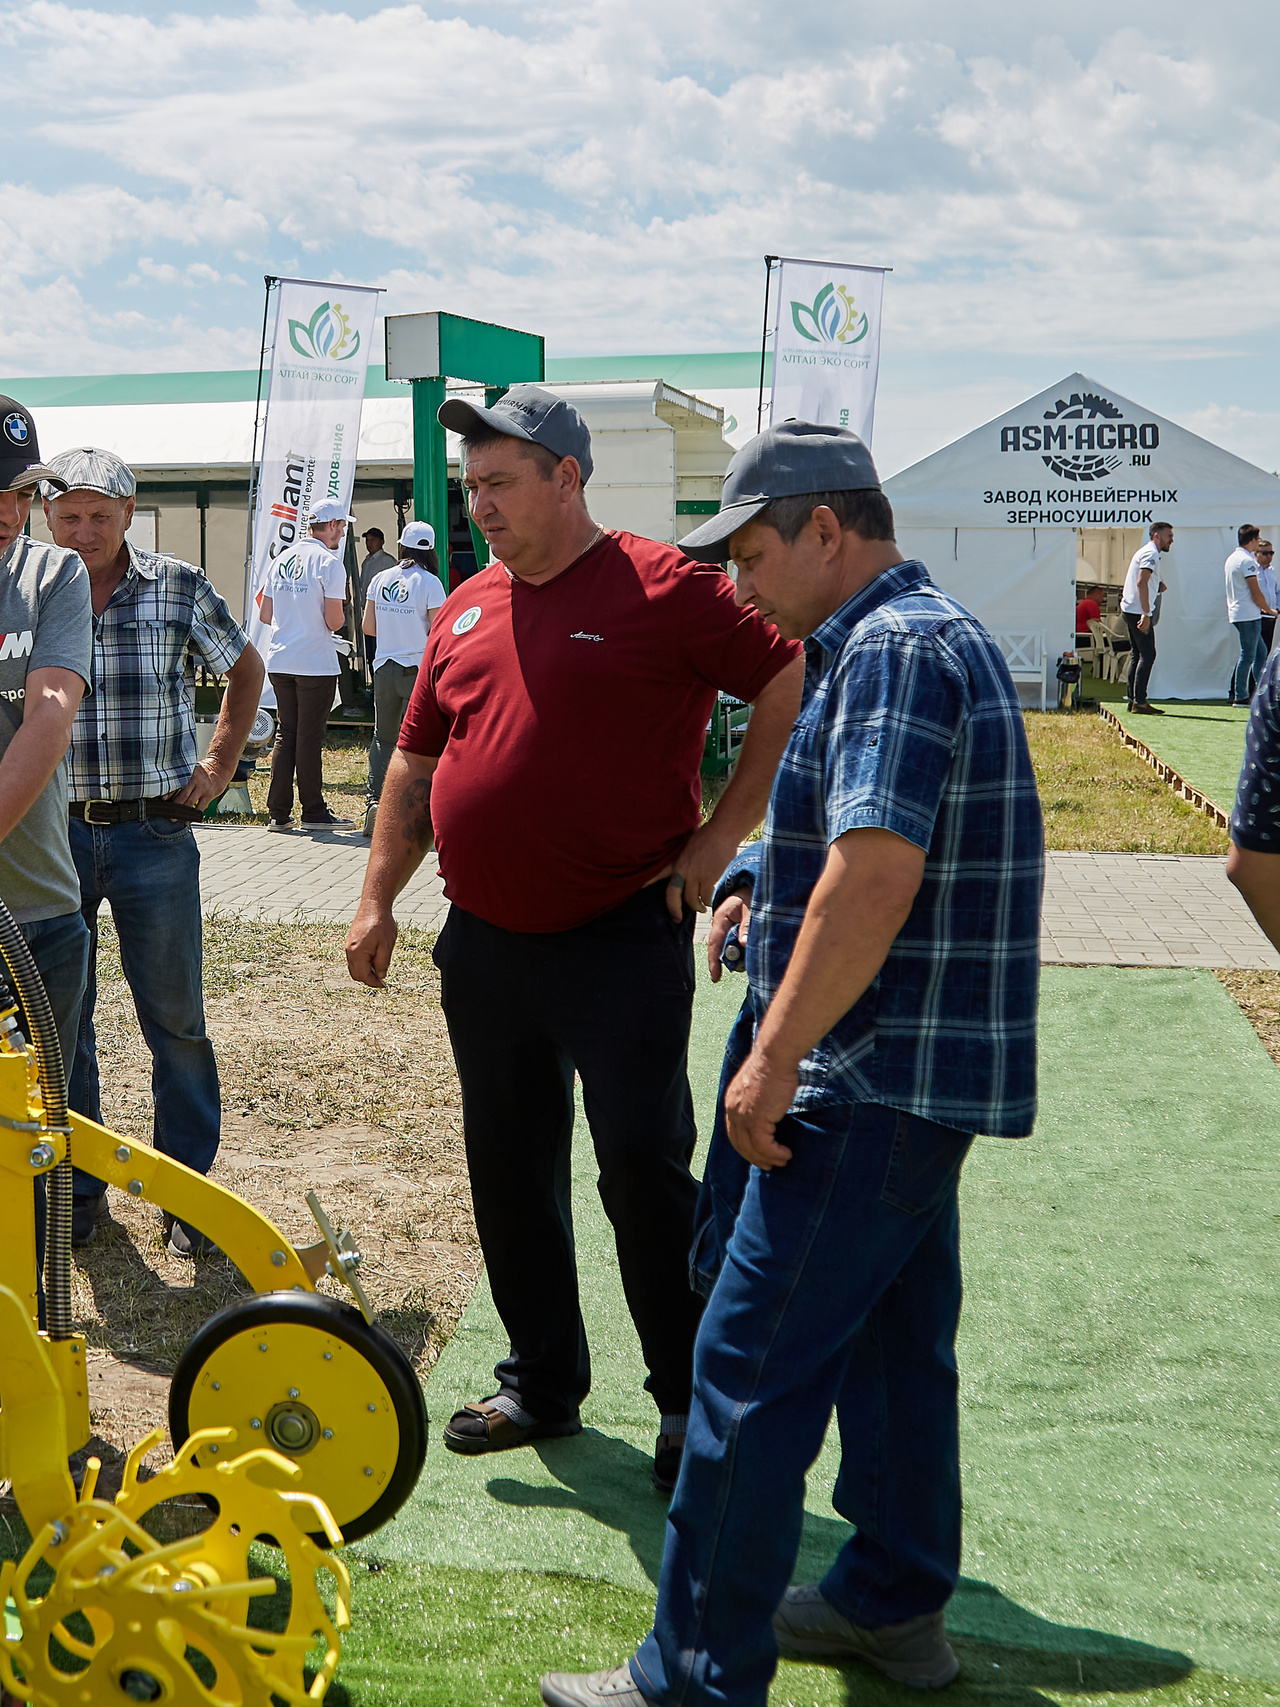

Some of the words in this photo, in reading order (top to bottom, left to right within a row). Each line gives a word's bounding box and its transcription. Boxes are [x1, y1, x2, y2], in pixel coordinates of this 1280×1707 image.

[782, 354, 817, 365] АЛТАЙ
[820, 356, 841, 367] ЭКО
[843, 359, 870, 369] СОРТ
[277, 369, 309, 380] АЛТАЙ
[311, 373, 333, 382] ЭКО
[334, 375, 358, 385] СОРТ
[326, 422, 344, 499] удование
[305, 454, 317, 493] exporter
[301, 494, 311, 511] and
[983, 490, 1042, 506] ЗАВОД
[1046, 486, 1178, 503] КОНВЕЙЕРНЫХ
[1006, 509, 1153, 524] ЗЕРНОСУШИЛОК
[399, 607, 415, 615] СОРТ
